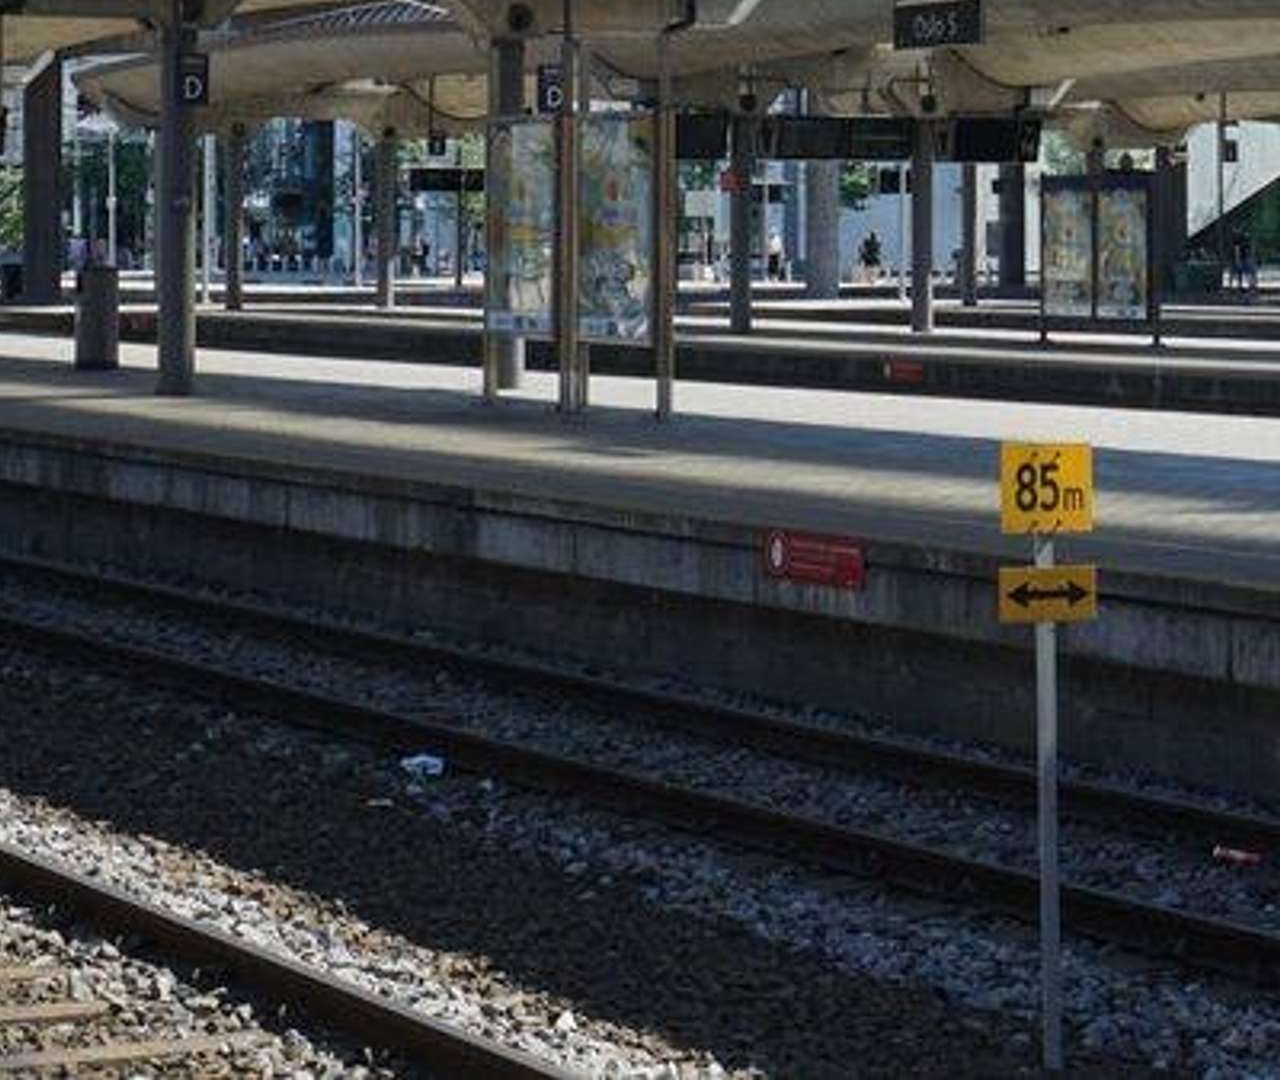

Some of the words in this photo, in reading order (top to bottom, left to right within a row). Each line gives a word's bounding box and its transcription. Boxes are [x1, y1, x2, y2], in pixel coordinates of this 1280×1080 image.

[183, 74, 203, 100] D
[546, 85, 565, 108] D
[1015, 462, 1084, 513] 85m
